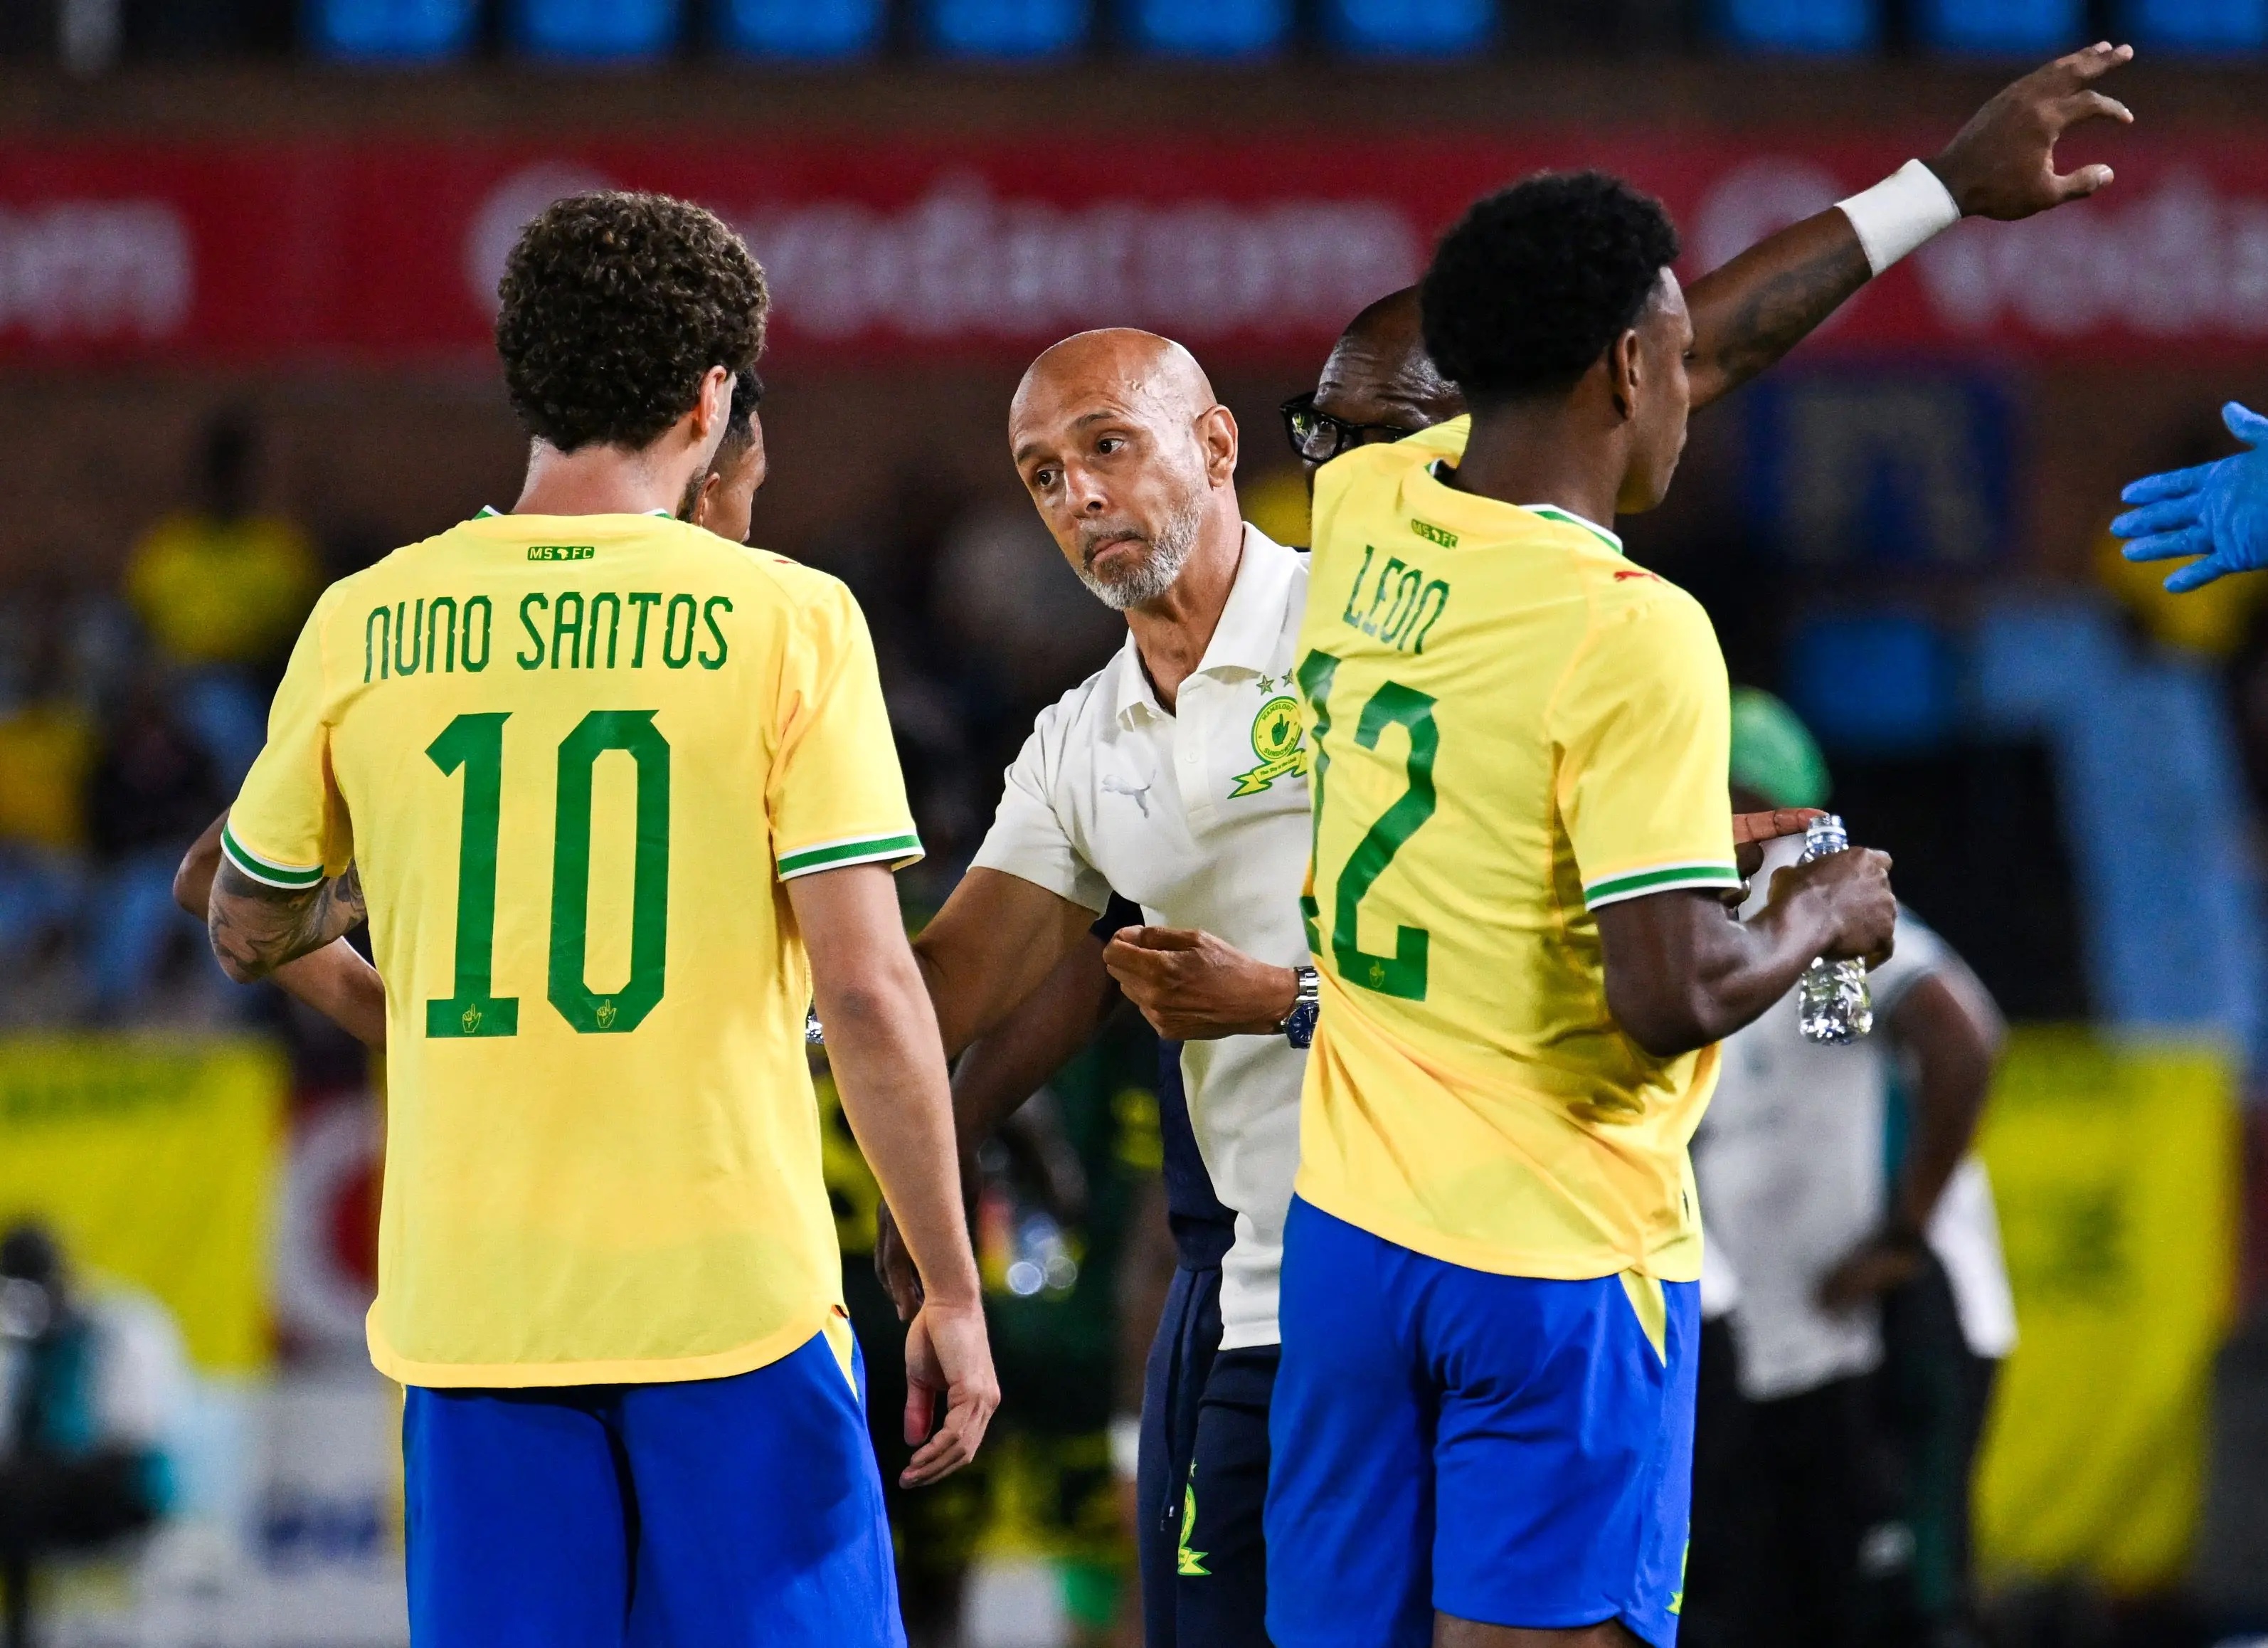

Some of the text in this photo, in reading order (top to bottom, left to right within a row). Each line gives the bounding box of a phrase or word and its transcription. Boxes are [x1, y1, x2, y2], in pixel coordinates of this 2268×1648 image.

[530, 548, 591, 559] MS FC
[364, 592, 733, 682] NUNO SANTOS
[1342, 544, 1450, 655] LEON
[1262, 704, 1293, 720] MAMELODI
[1263, 737, 1295, 756] SUNDOWNS
[1298, 648, 1439, 1001] 12
[425, 709, 670, 1037] 10
